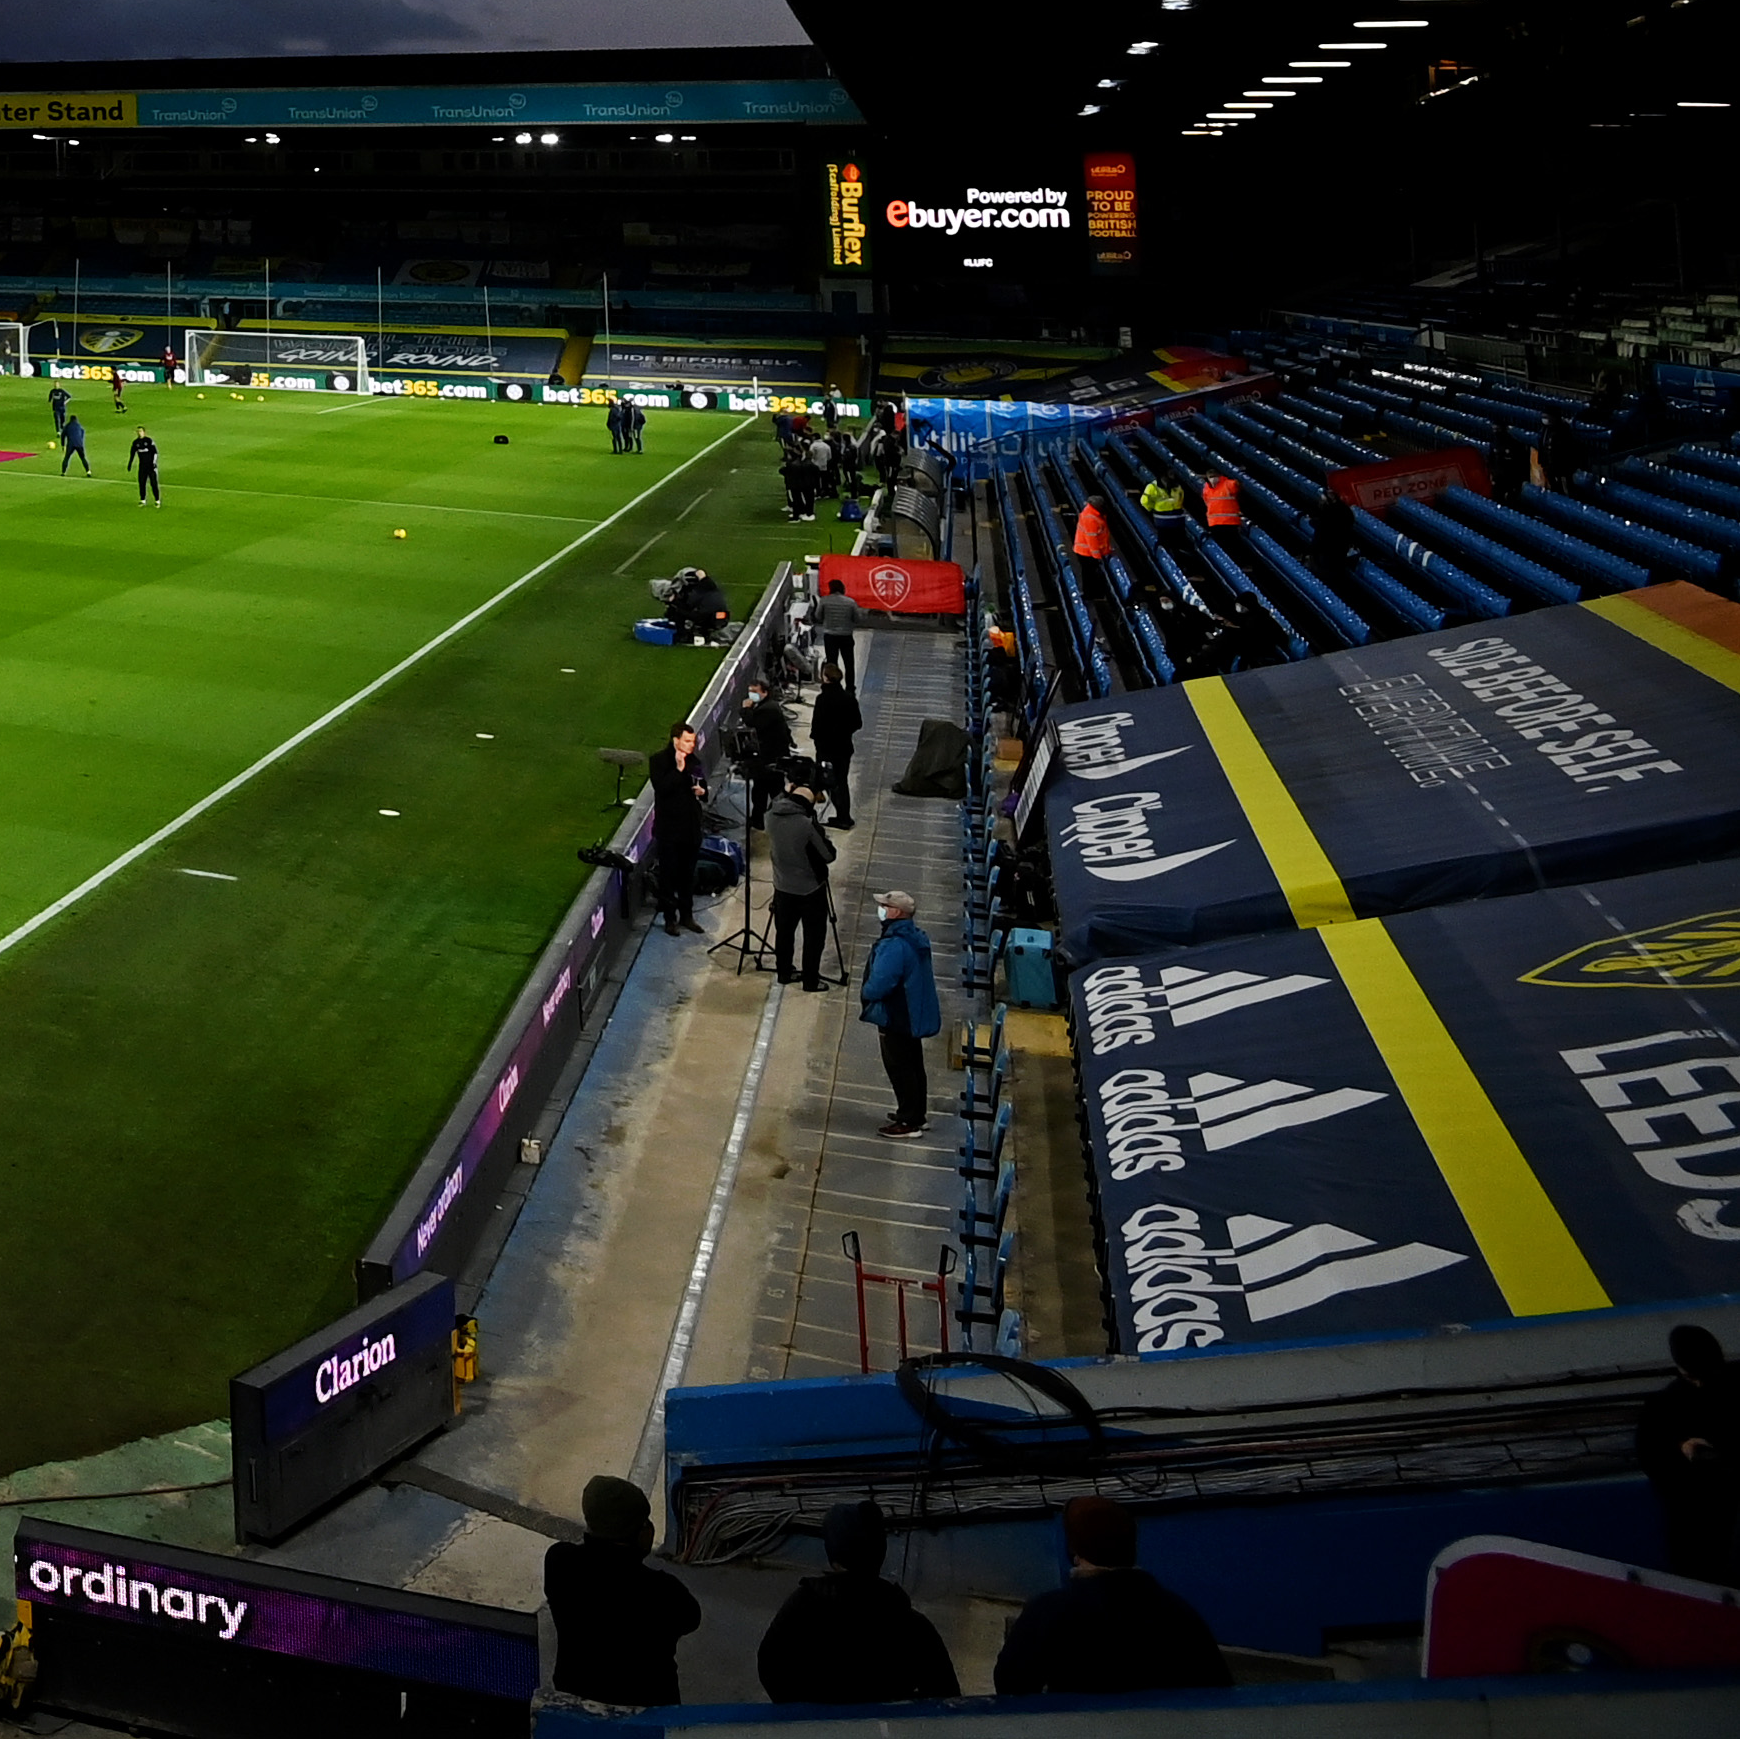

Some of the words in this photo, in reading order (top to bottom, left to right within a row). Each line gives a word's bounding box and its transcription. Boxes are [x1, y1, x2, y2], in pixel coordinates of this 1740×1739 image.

[47, 99, 123, 122] Stand
[153, 109, 226, 121] TransUnion
[288, 107, 366, 120] TransUnion
[432, 105, 514, 119] TransUnion
[583, 102, 670, 117] TransUnion
[743, 100, 835, 115] TransUnion
[966, 187, 1044, 205] Powered
[1044, 187, 1068, 206] by
[1086, 190, 1135, 201] PROUD
[1091, 201, 1111, 212] TO
[1114, 201, 1131, 212] BE
[840, 181, 867, 266] Burflex
[886, 199, 1072, 236] ebuyer.com
[1088, 219, 1137, 229] BRITISH
[1089, 229, 1137, 238] FOOTBALL
[385, 353, 500, 367] ROUND.
[611, 353, 659, 362] SIDE
[662, 355, 744, 365] BEFORE
[370, 377, 487, 399] bet365.com
[728, 392, 860, 418] bet365.cm
[1372, 486, 1402, 501] RED
[1427, 637, 1532, 678] SIDE
[1460, 664, 1617, 740] BEFORE
[1058, 711, 1135, 773] Clipper
[1536, 729, 1685, 793] SELF.
[1060, 790, 1162, 867] Clipper
[1082, 965, 1171, 1057] adidas
[1097, 1068, 1202, 1181] adidas
[416, 1200, 439, 1259] Never
[436, 1161, 464, 1221] ordinary
[1121, 1203, 1245, 1353] adidas
[313, 1326, 396, 1405] Clarion
[29, 1550, 252, 1640] ordinary
